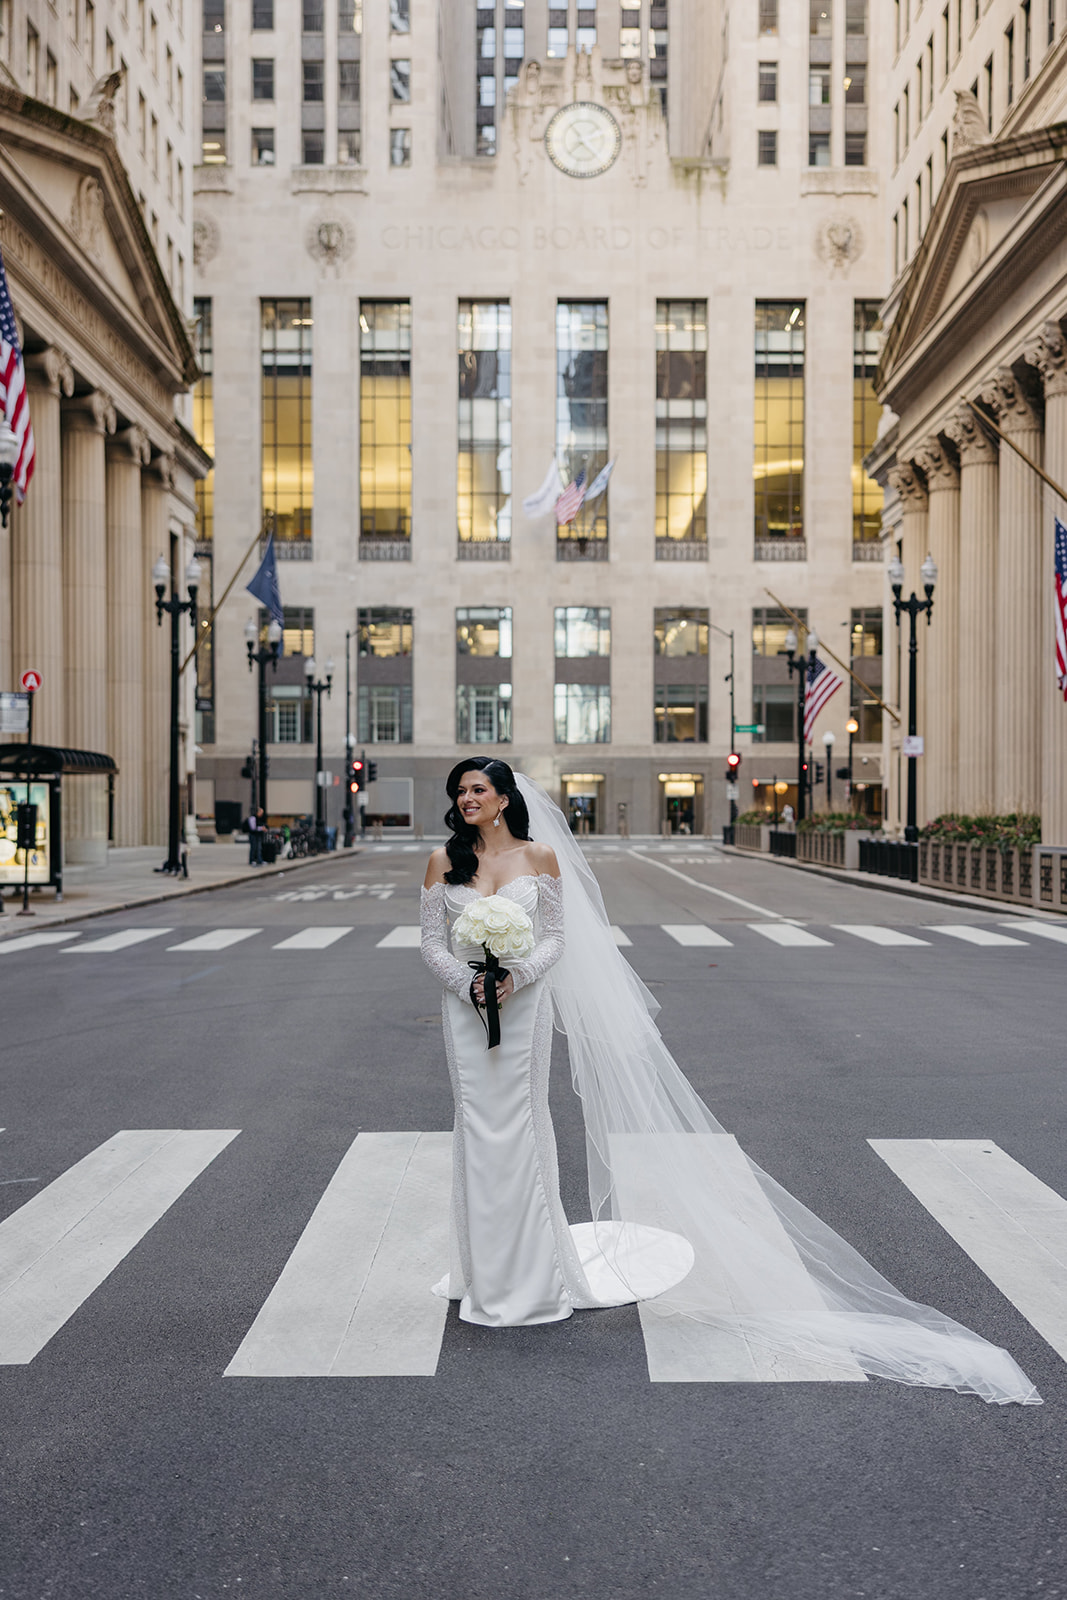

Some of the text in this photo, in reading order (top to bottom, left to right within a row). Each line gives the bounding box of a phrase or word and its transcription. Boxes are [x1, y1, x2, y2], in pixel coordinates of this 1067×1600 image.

[381, 224, 792, 250] CHICAGO BOARD OF TRADE
[25, 673, 38, 687] A
